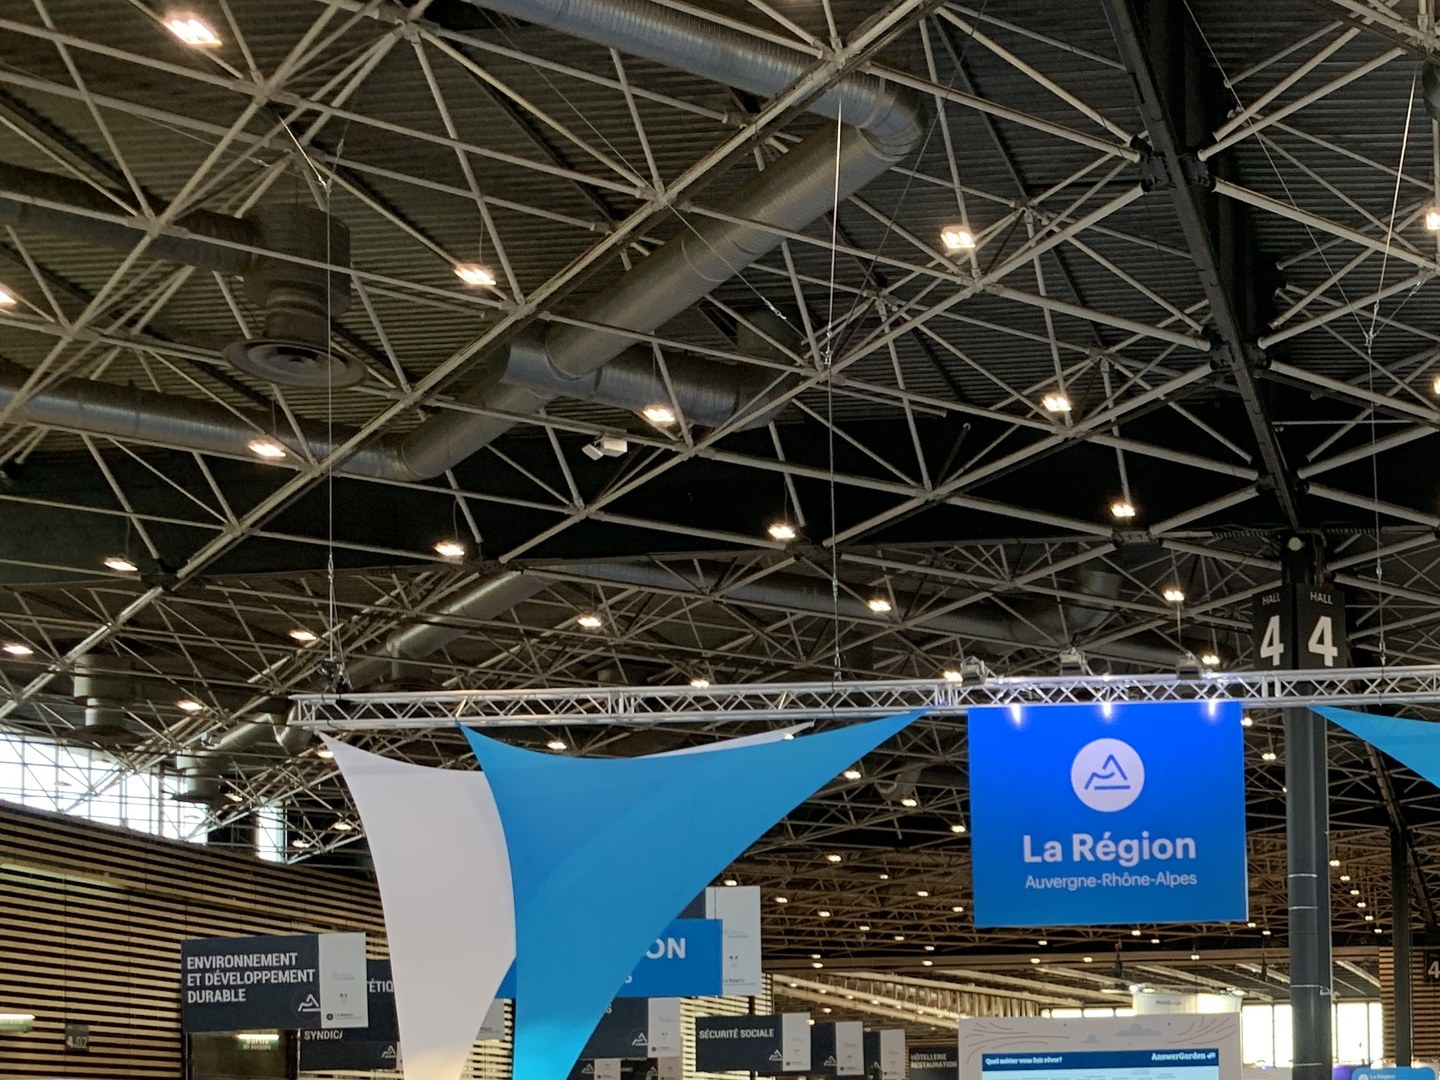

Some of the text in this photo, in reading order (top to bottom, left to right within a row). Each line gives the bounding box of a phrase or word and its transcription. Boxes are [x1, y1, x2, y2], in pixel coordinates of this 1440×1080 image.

[1262, 592, 1281, 606] HALL
[1310, 591, 1333, 605] HALL
[1260, 615, 1284, 666] 4
[1308, 615, 1338, 667] 4
[1023, 830, 1197, 868] La Région
[1025, 870, 1198, 891] Auvergne-Rhône-Alpes
[187, 953, 298, 970] ENVIRONNEMENT
[1428, 961, 1440, 978] 4
[187, 968, 315, 986] ET DÉVELOPPEMENT
[187, 988, 246, 1003] DURABLE
[304, 1030, 343, 1040] SYNDIC
[699, 1028, 774, 1040] SÉCURITÉ SOCIALE
[1151, 1052, 1206, 1061] AnswerGarden
